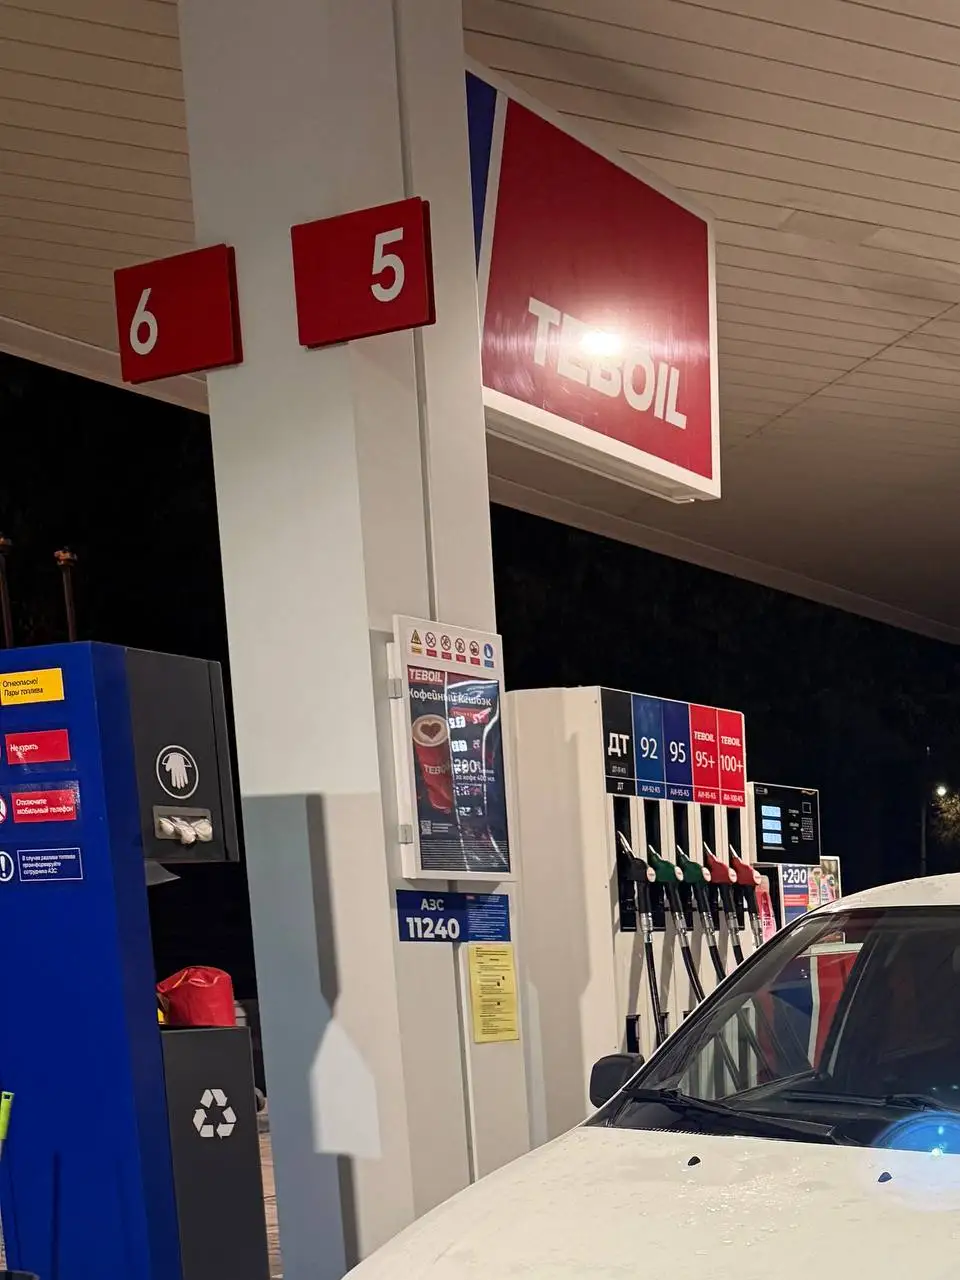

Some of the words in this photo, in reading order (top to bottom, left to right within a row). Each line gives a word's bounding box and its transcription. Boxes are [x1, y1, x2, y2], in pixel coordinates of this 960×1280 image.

[370, 227, 405, 302] 5
[130, 287, 158, 355] 6
[528, 297, 688, 430] TEBOIL
[408, 668, 443, 683] TEBOIL
[607, 732, 630, 757] ДТ
[640, 736, 659, 760] 92
[694, 731, 715, 743] TEBOIL
[720, 735, 741, 747] TEBOIL
[669, 741, 686, 763] 95
[695, 751, 715, 769] 95+
[720, 755, 744, 773] 100+
[420, 898, 444, 911] АЗС
[405, 917, 460, 939] 11240
